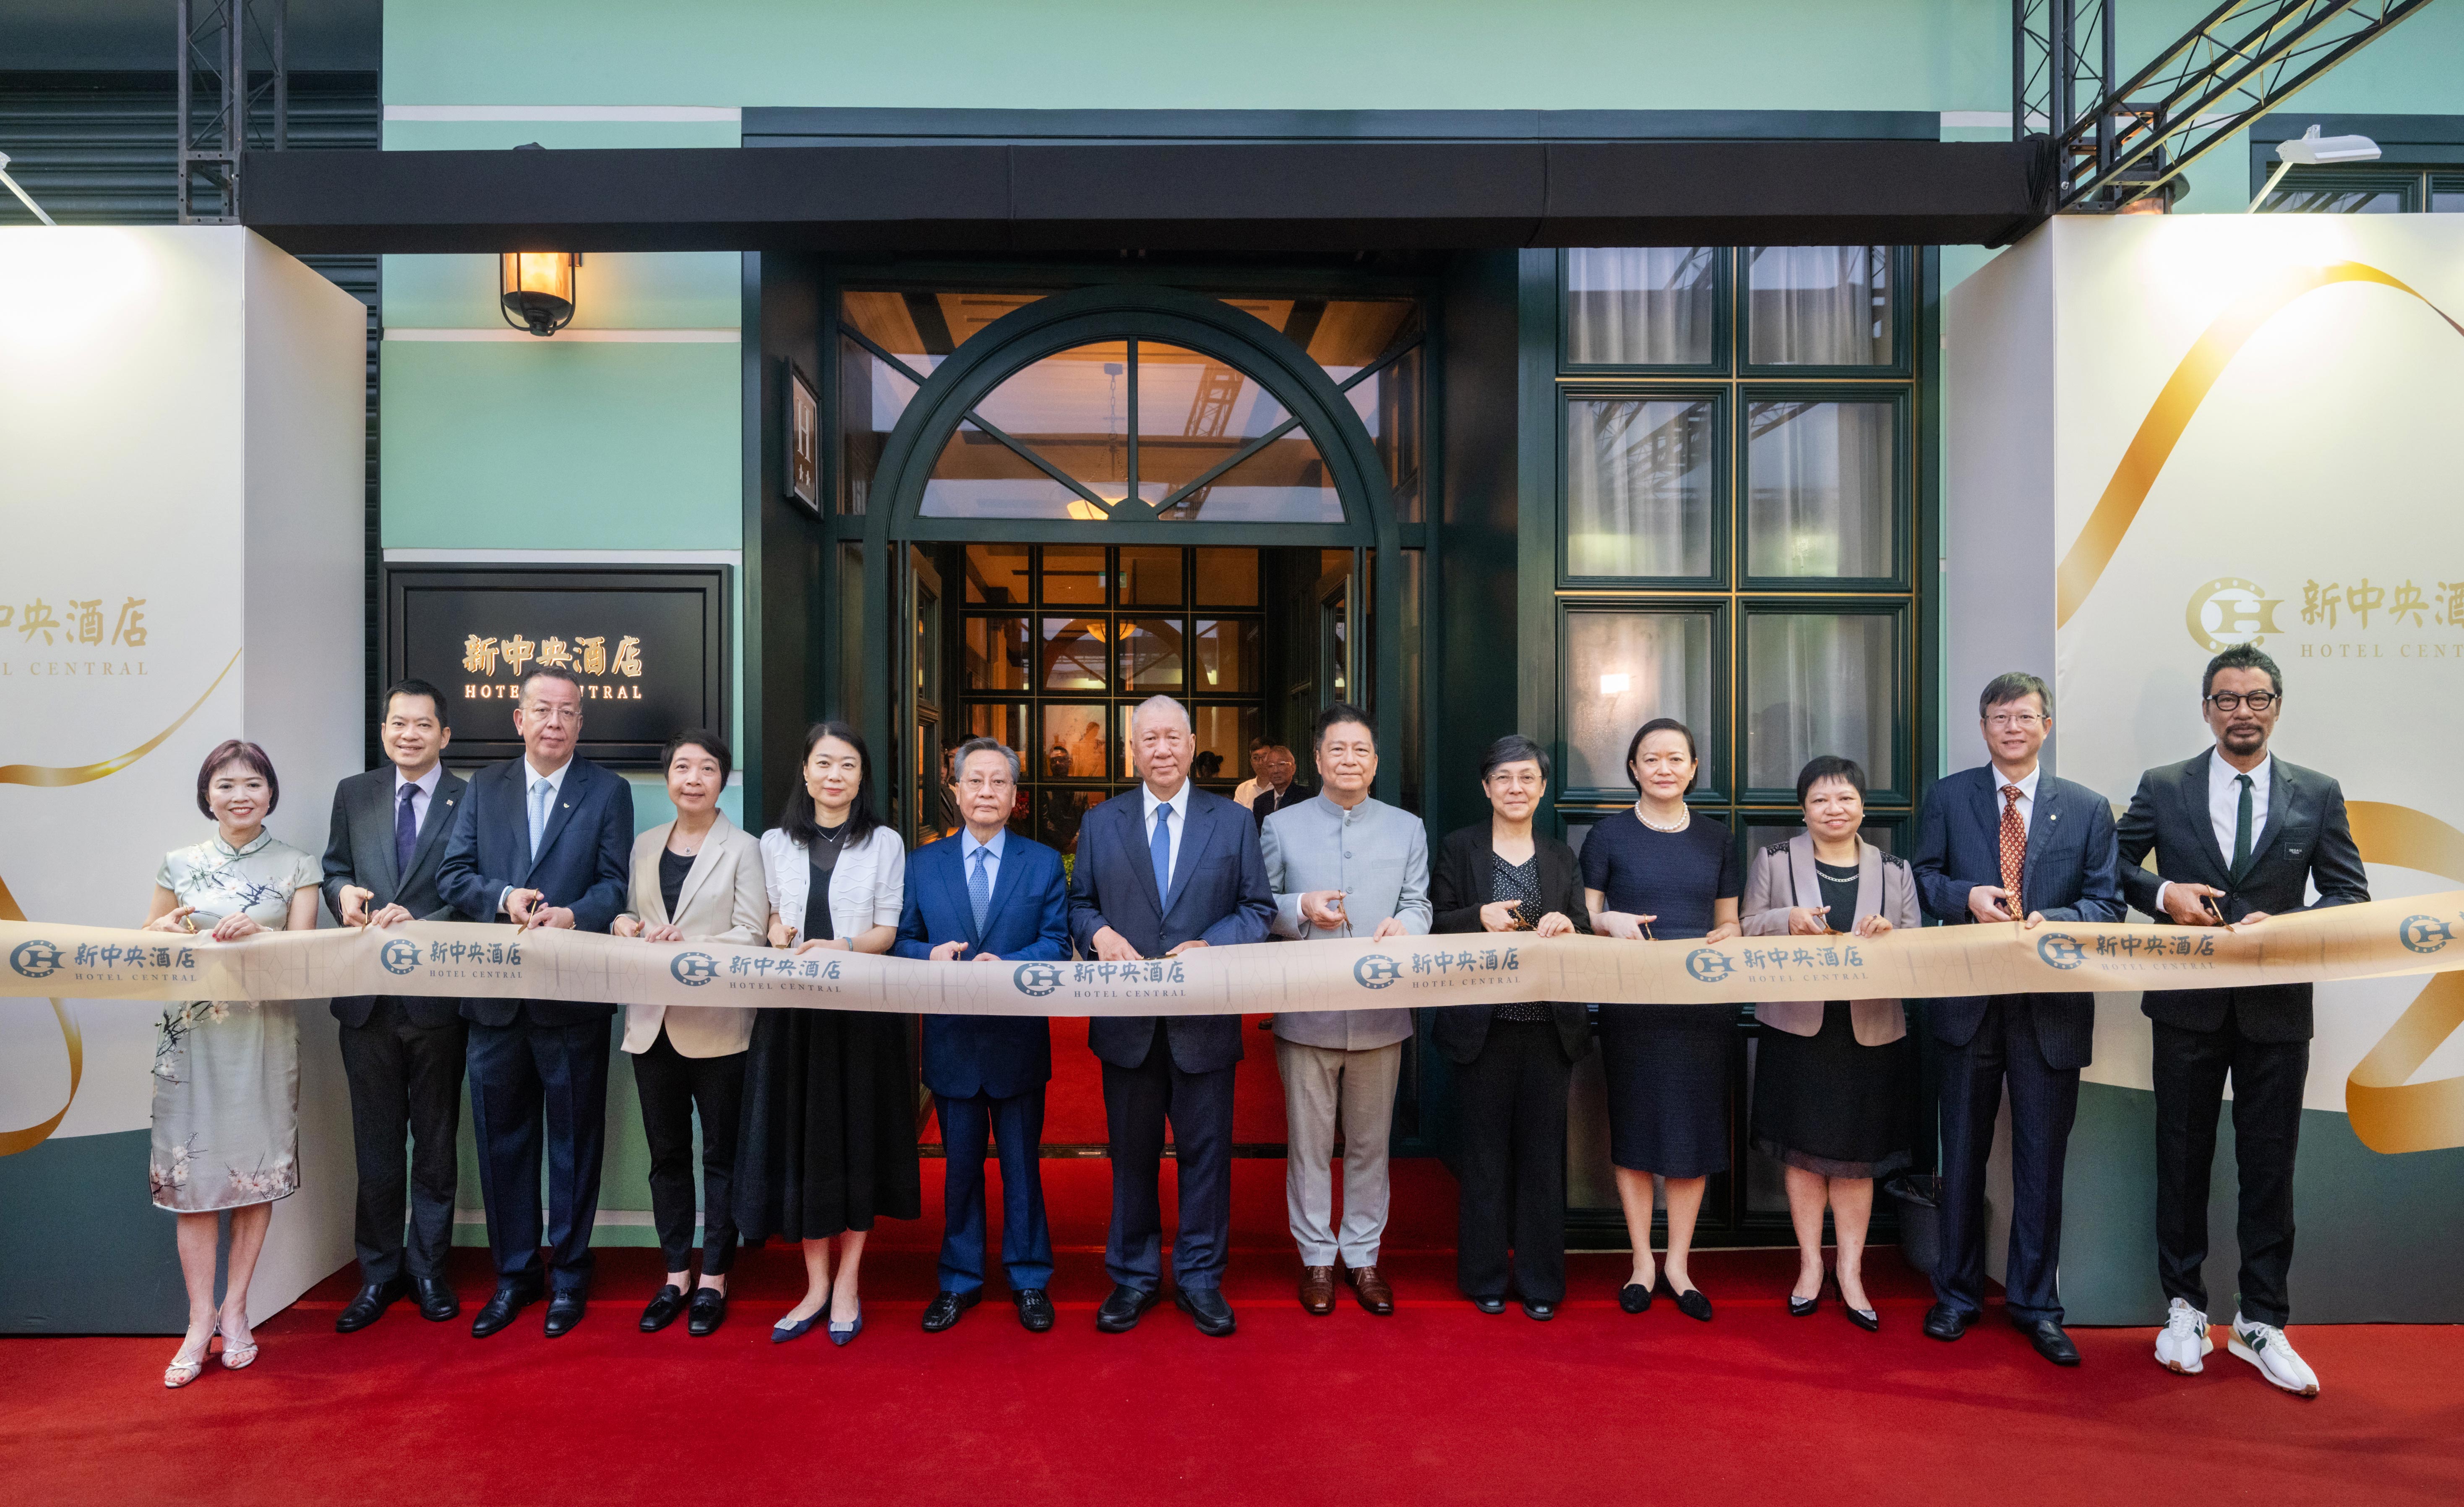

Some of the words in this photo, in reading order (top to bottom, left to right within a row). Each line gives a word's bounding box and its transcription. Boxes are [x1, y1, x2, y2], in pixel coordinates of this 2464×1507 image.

[463, 634, 642, 676] 新中央酒店
[2300, 644, 2383, 657] HOTEL
[30, 662, 148, 675] CENTRAL
[465, 684, 519, 698] HOTE
[74, 943, 195, 968] 新中央酒店
[430, 940, 521, 966] 新中央酒店
[2096, 934, 2214, 957] 新中央酒店
[729, 956, 842, 979] 新中央酒店
[1411, 947, 1519, 974] 新中央酒店
[1743, 945, 1863, 970] 新中央酒店
[1074, 961, 1185, 984] 新中央酒店
[1463, 977, 1520, 985] CENTRAL
[1803, 973, 1868, 981] CENTRAL
[781, 983, 841, 992] CENTRAL
